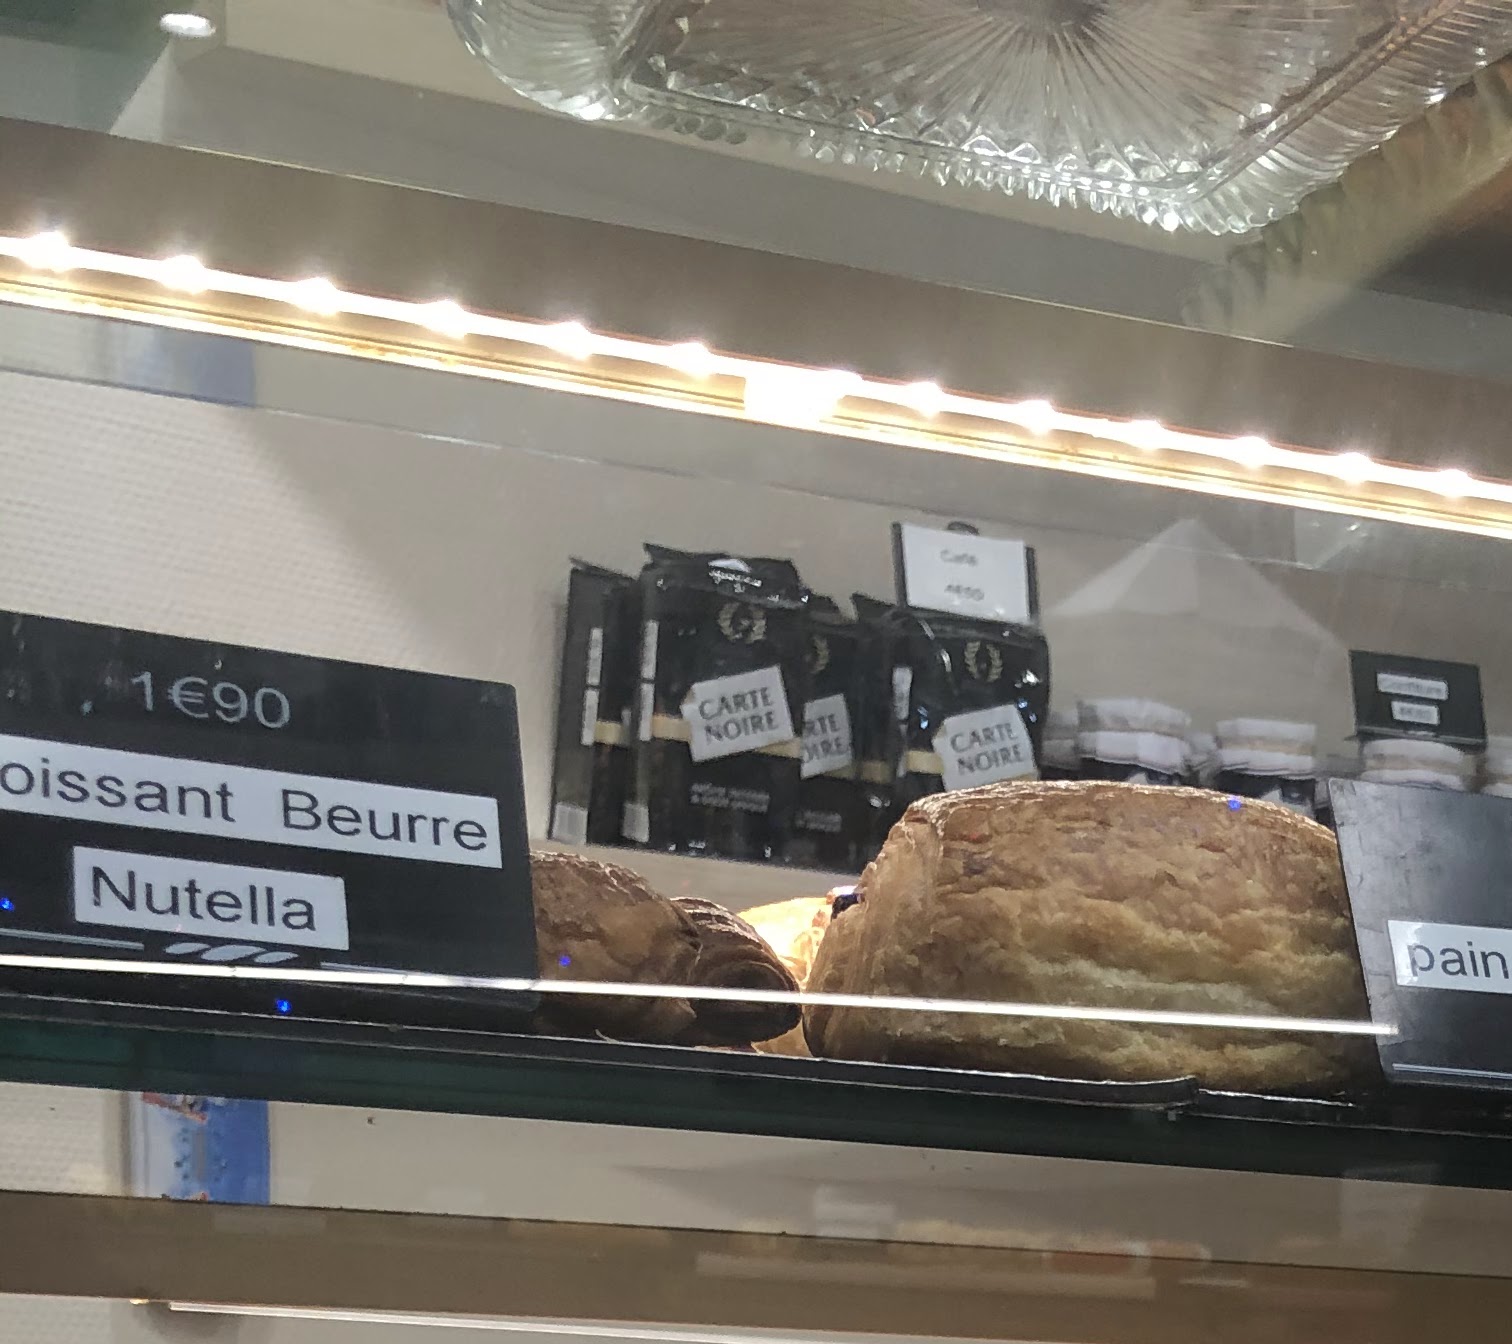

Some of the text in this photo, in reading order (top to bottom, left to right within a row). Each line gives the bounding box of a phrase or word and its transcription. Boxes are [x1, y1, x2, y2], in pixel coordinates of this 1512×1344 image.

[131, 670, 291, 730] 1€90
[698, 687, 774, 720] CARTE
[705, 711, 778, 745] NOIRE
[950, 722, 1018, 753] CARTE
[957, 744, 1026, 776] NOIRE
[282, 788, 488, 853] Beurre
[91, 866, 317, 932] Nutella
[1410, 940, 1508, 986] pain
